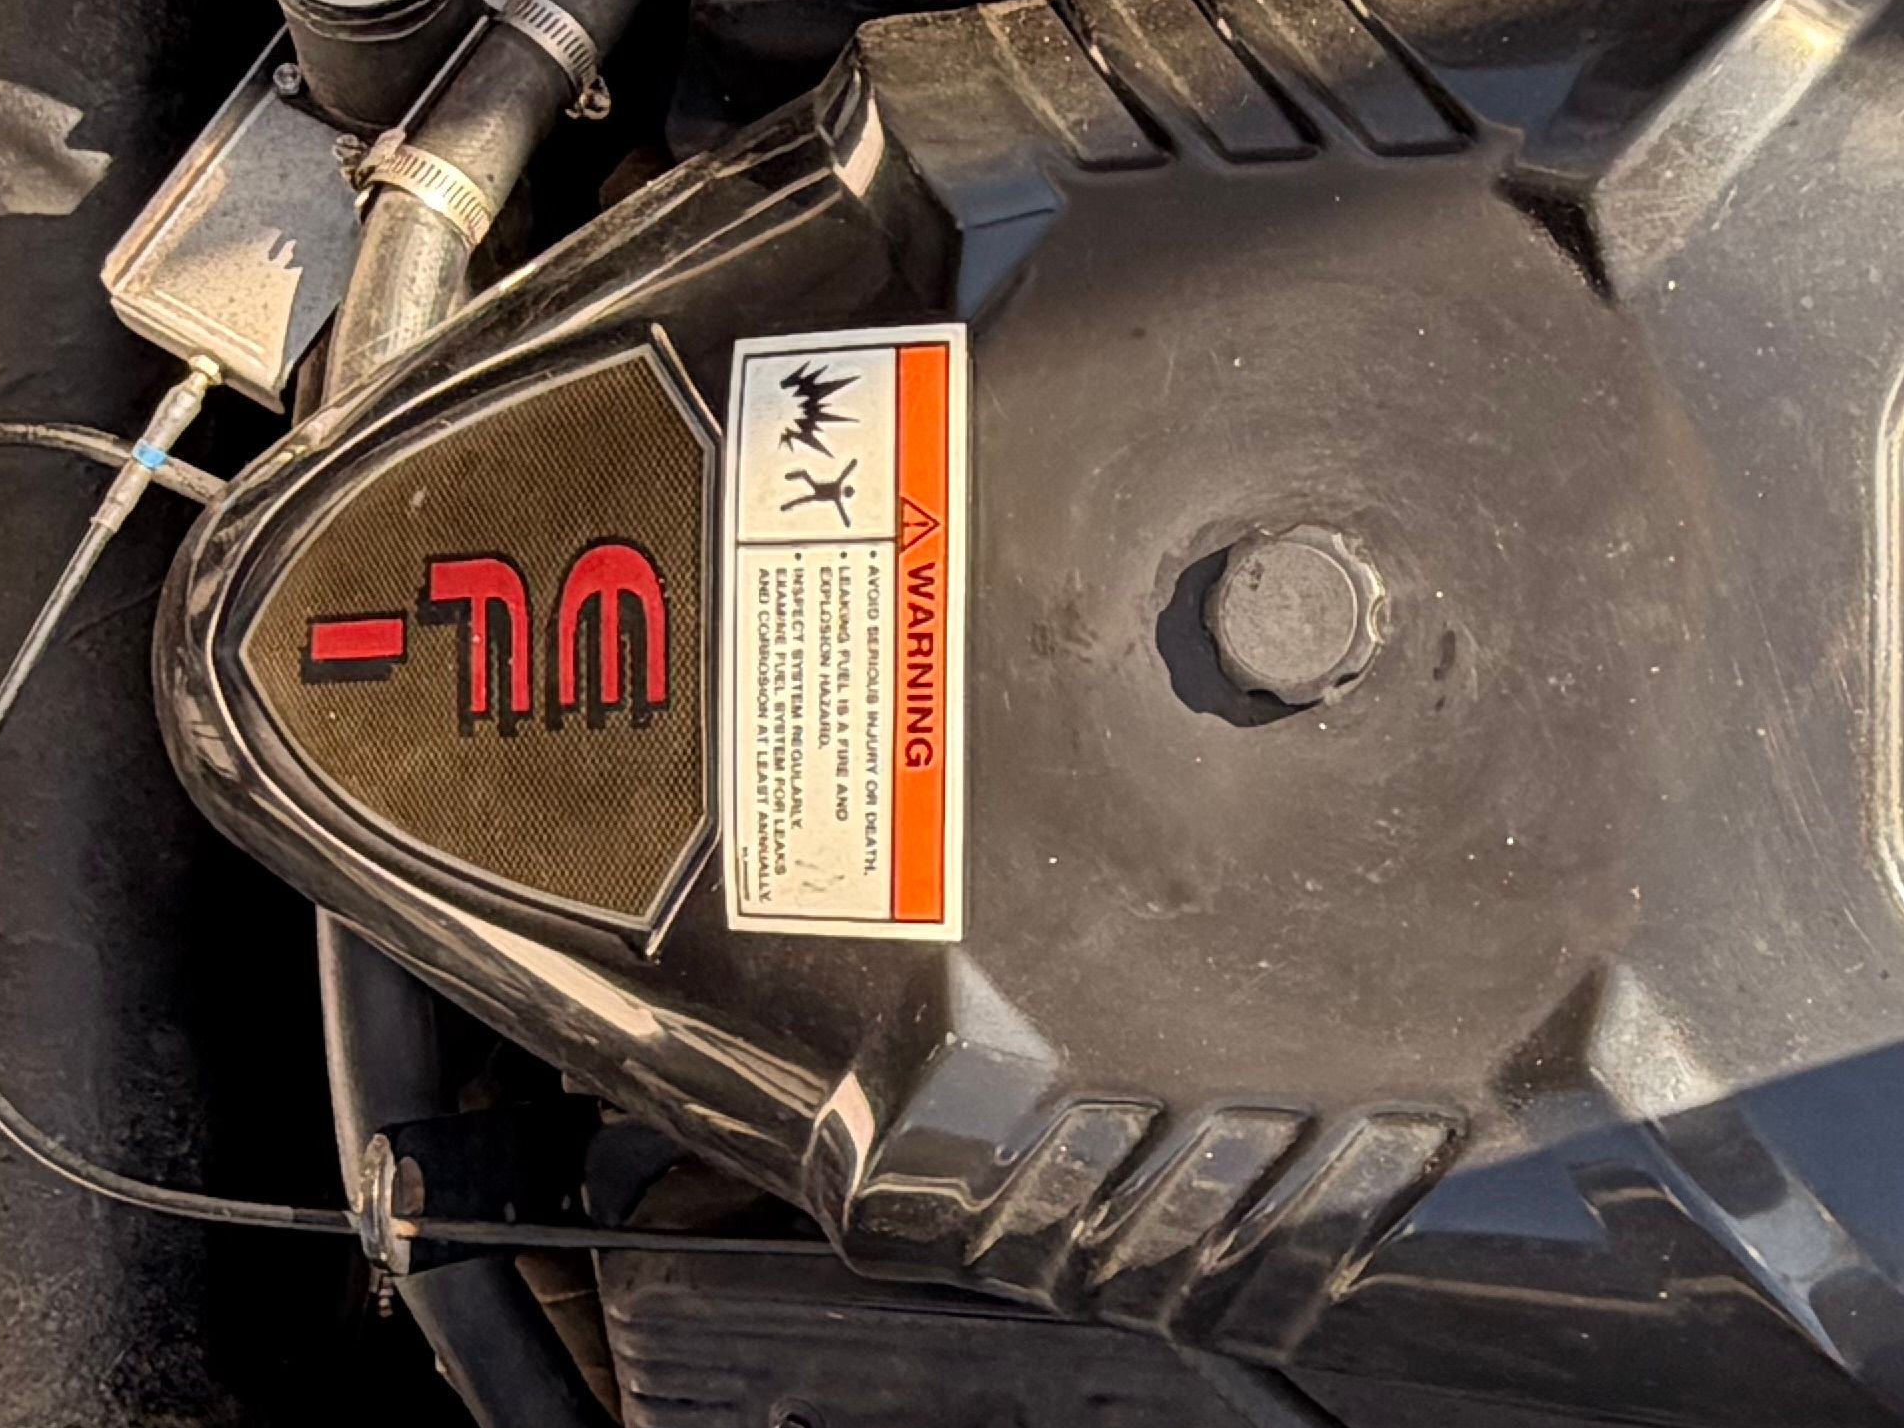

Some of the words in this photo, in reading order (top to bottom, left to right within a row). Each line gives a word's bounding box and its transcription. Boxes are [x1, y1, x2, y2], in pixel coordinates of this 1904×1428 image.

[758, 568, 770, 604] AND
[791, 567, 804, 643] INSPECT
[819, 566, 832, 667] EXPLOSION
[838, 566, 851, 643] LEAKING
[868, 565, 880, 620] AVOID
[308, 543, 668, 722] EFI
[757, 610, 770, 718] CORROSION
[774, 652, 786, 695] FUEL
[791, 648, 804, 719] SYSTEM
[837, 649, 850, 693] FUEL
[866, 626, 879, 704] SERIOUS
[904, 560, 934, 769] WARNING
[757, 724, 769, 746] AT
[773, 701, 786, 771] SYSTEM
[818, 673, 831, 749] HAZARD.
[837, 699, 849, 715] IS
[837, 721, 849, 733] A
[836, 738, 849, 777] FIRE
[866, 711, 879, 775] INJURY
[757, 750, 769, 804] LEAST
[773, 777, 786, 813] FOR
[790, 725, 803, 829] REGULARLY
[836, 784, 849, 822] AND
[865, 780, 878, 805] OR
[774, 818, 787, 876] LEAKS
[864, 812, 878, 876] DEATH.
